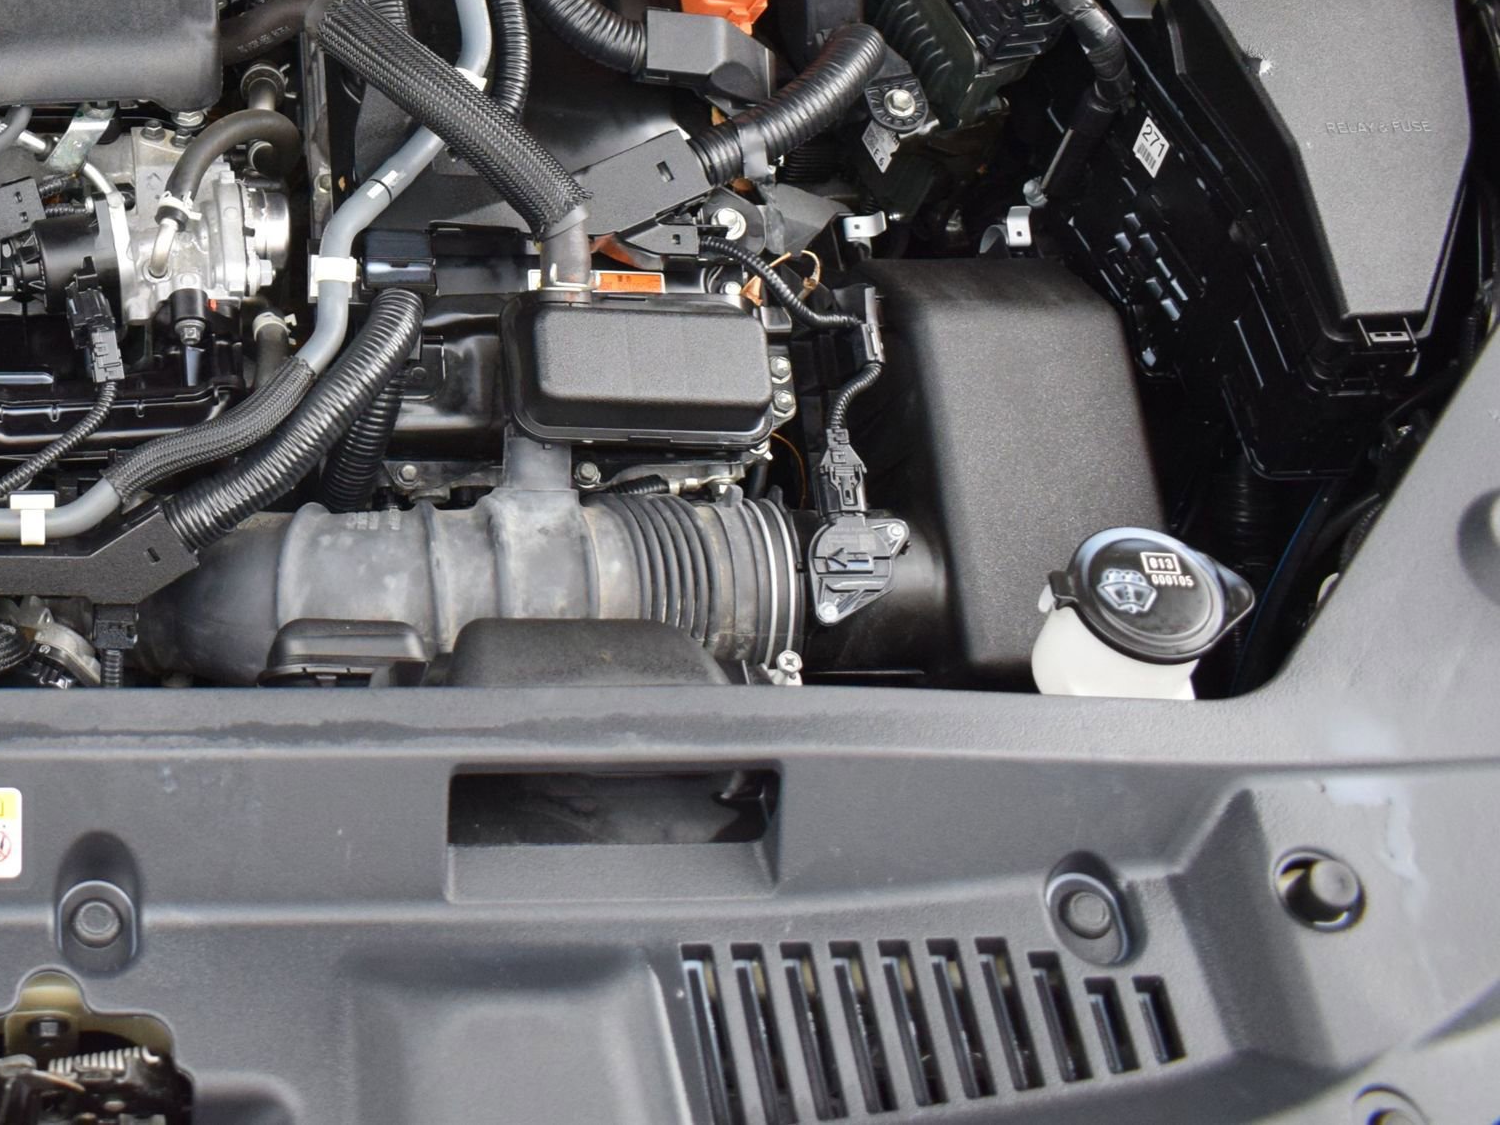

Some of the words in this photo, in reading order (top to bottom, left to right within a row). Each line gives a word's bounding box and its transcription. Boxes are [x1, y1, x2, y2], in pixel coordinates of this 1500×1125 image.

[1325, 122, 1374, 134] RELAY
[1379, 123, 1389, 133] &
[1391, 120, 1433, 133] FUSE
[1141, 123, 1165, 158] 271
